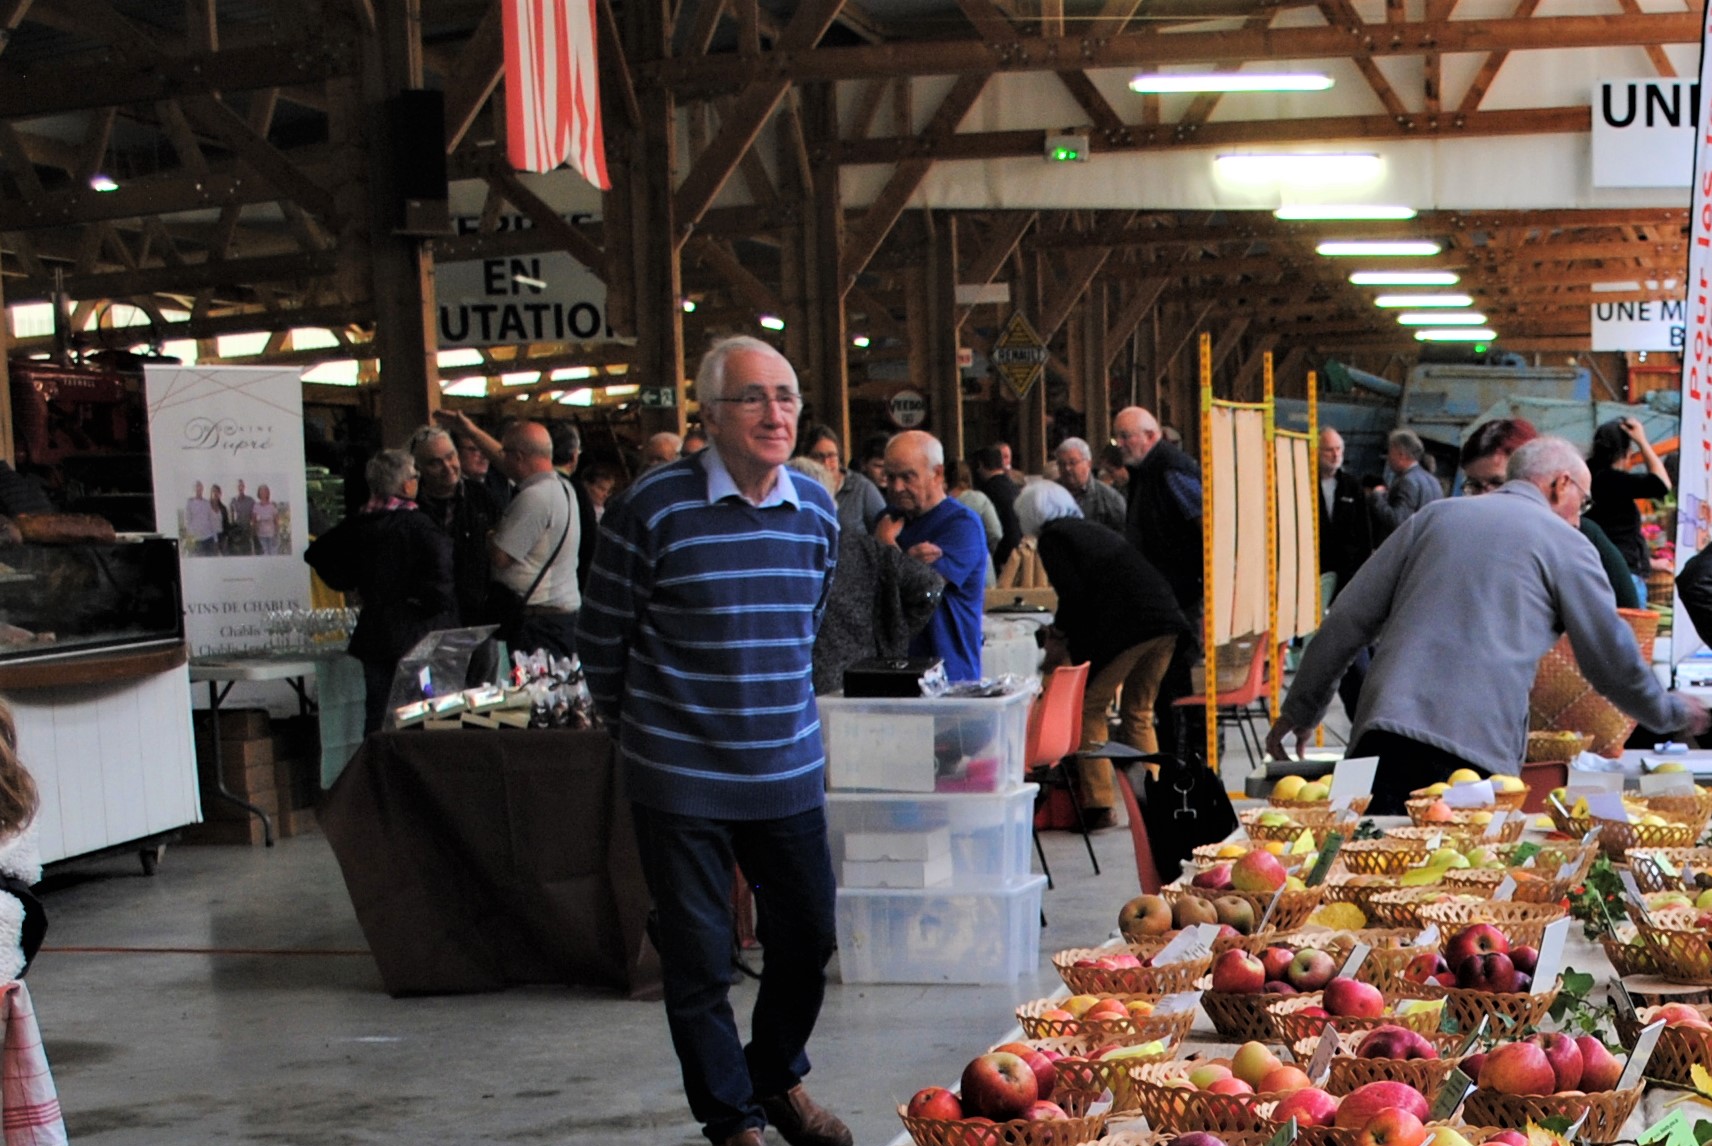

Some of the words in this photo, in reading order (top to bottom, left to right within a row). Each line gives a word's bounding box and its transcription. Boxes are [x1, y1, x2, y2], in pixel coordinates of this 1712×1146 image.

[484, 258, 542, 296] EN
[440, 302, 614, 342] UTATIO
[1597, 300, 1650, 322] UNE
[1689, 268, 1707, 401] Pour
[891, 400, 925, 412] VEEDO
[182, 416, 274, 456] Dupré
[188, 603, 218, 615] VINS
[222, 602, 239, 614] DE
[243, 600, 299, 613] CHABLIS
[220, 624, 261, 638] Chablis
